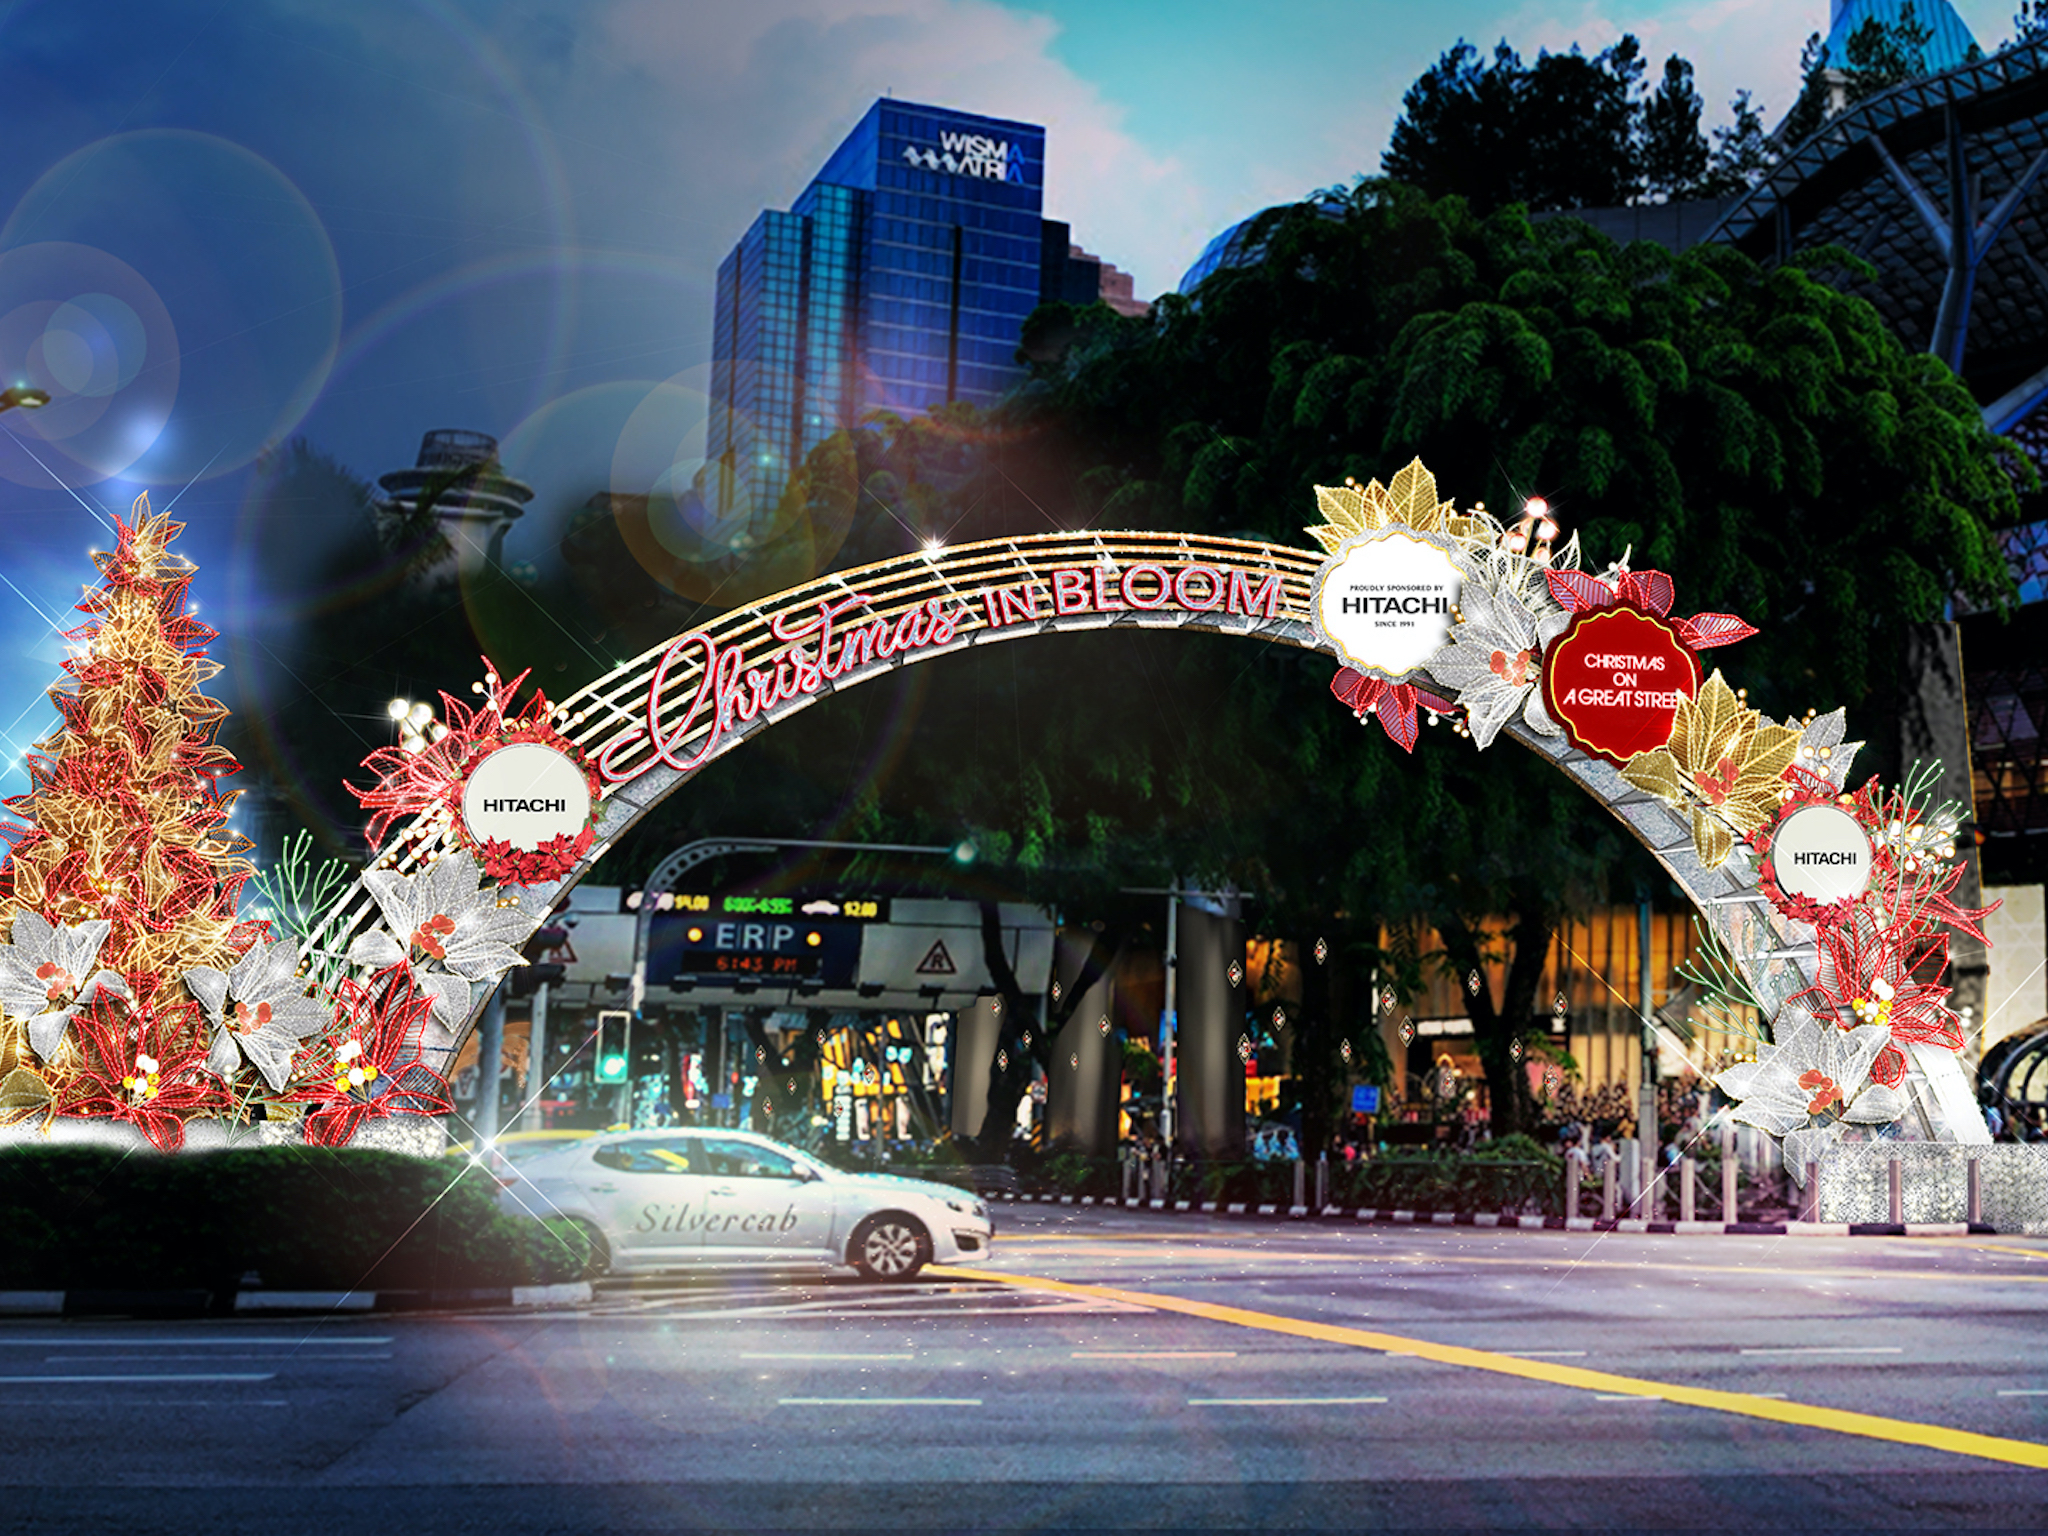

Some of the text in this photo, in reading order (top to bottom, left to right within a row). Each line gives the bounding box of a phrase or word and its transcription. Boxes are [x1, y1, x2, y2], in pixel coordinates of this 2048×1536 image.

[939, 130, 1025, 165] WISMA
[957, 154, 1024, 184] ATRIA
[1349, 584, 1444, 592] PROUDLY SPONSORED BY
[1342, 597, 1448, 614] HITACHI
[1584, 653, 1665, 671] CHRISTMAS
[599, 564, 1283, 783] Christmas IN BLOOM
[1612, 672, 1638, 688] ON
[1562, 688, 1687, 709] A GREAT STREE
[483, 799, 566, 812] HITACHI
[1794, 852, 1857, 865] HITACHI
[635, 1203, 798, 1233] Silvercab
